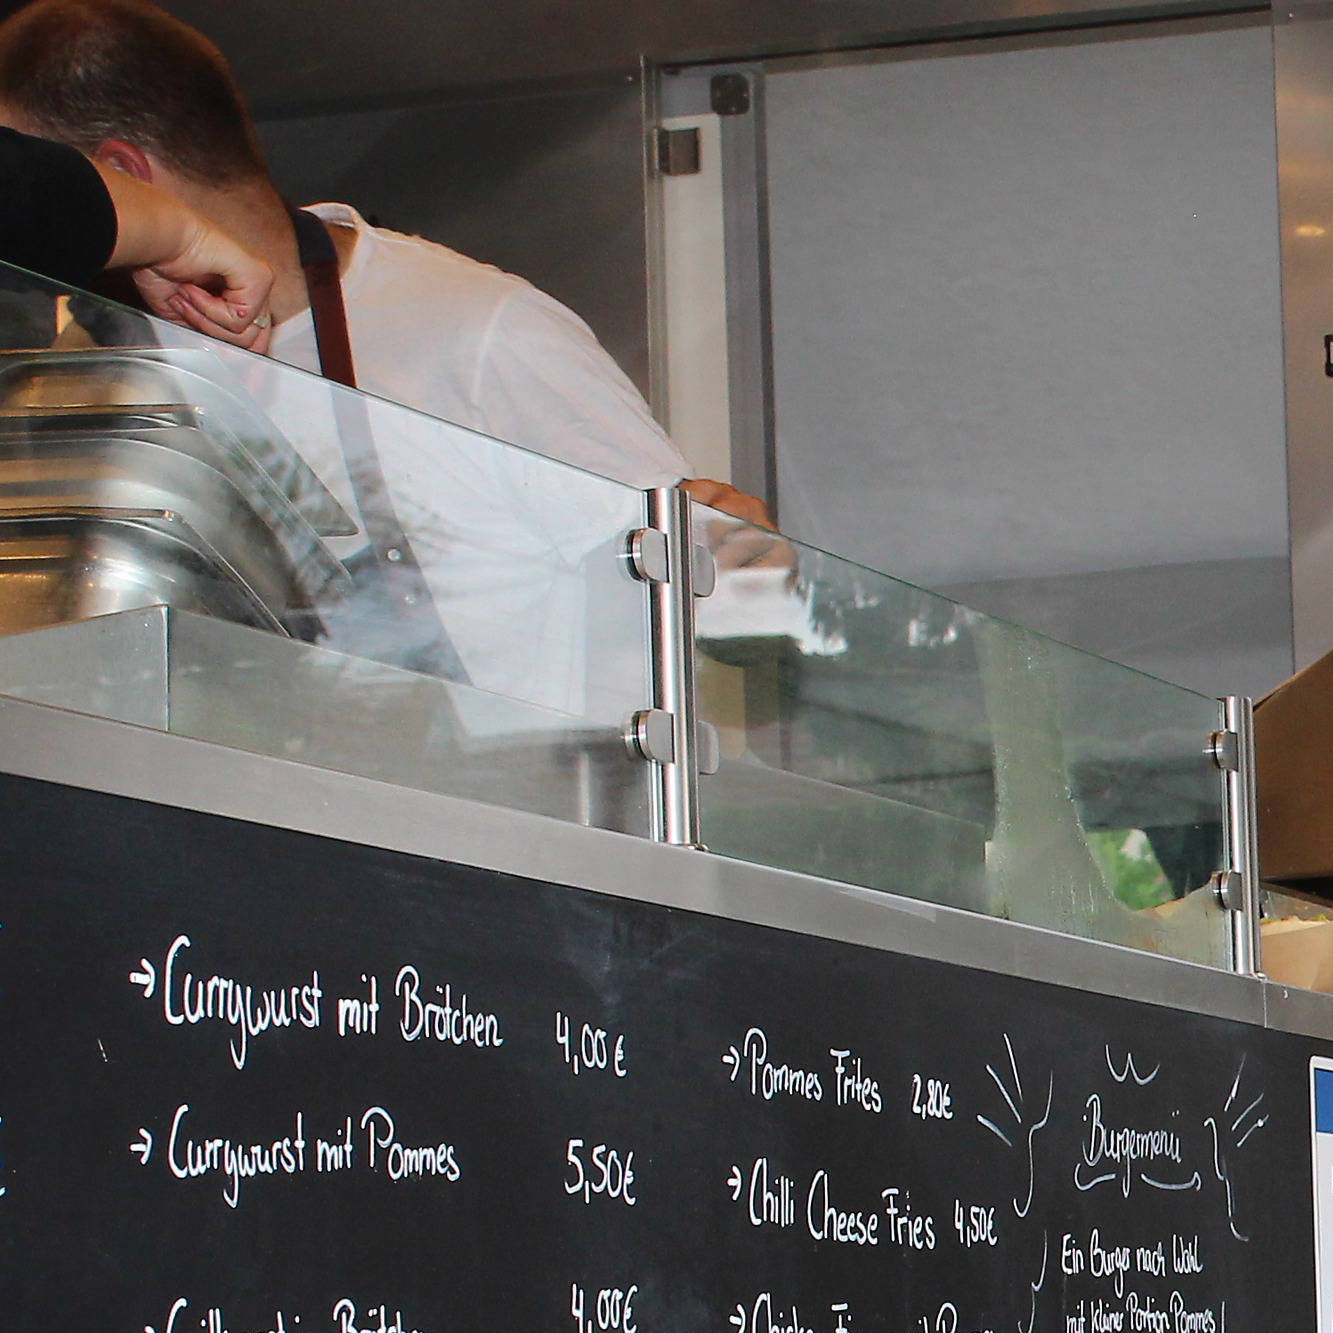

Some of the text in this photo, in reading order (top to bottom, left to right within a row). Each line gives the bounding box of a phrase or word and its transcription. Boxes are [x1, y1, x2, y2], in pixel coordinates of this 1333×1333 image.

[164, 935, 504, 1070] Currywurst mit Brötchen
[743, 1027, 882, 1113] Pommes Frites
[912, 1073, 954, 1120] 2,80€
[168, 1104, 461, 1209] Currywurst mit Pommes
[564, 1139, 636, 1206] 5,50€
[1082, 1093, 1182, 1199] Burgermenü
[749, 1157, 936, 1250] Chilli Cheese Fries
[954, 1199, 998, 1248] 4,50€
[1061, 1233, 1085, 1275] Ein
